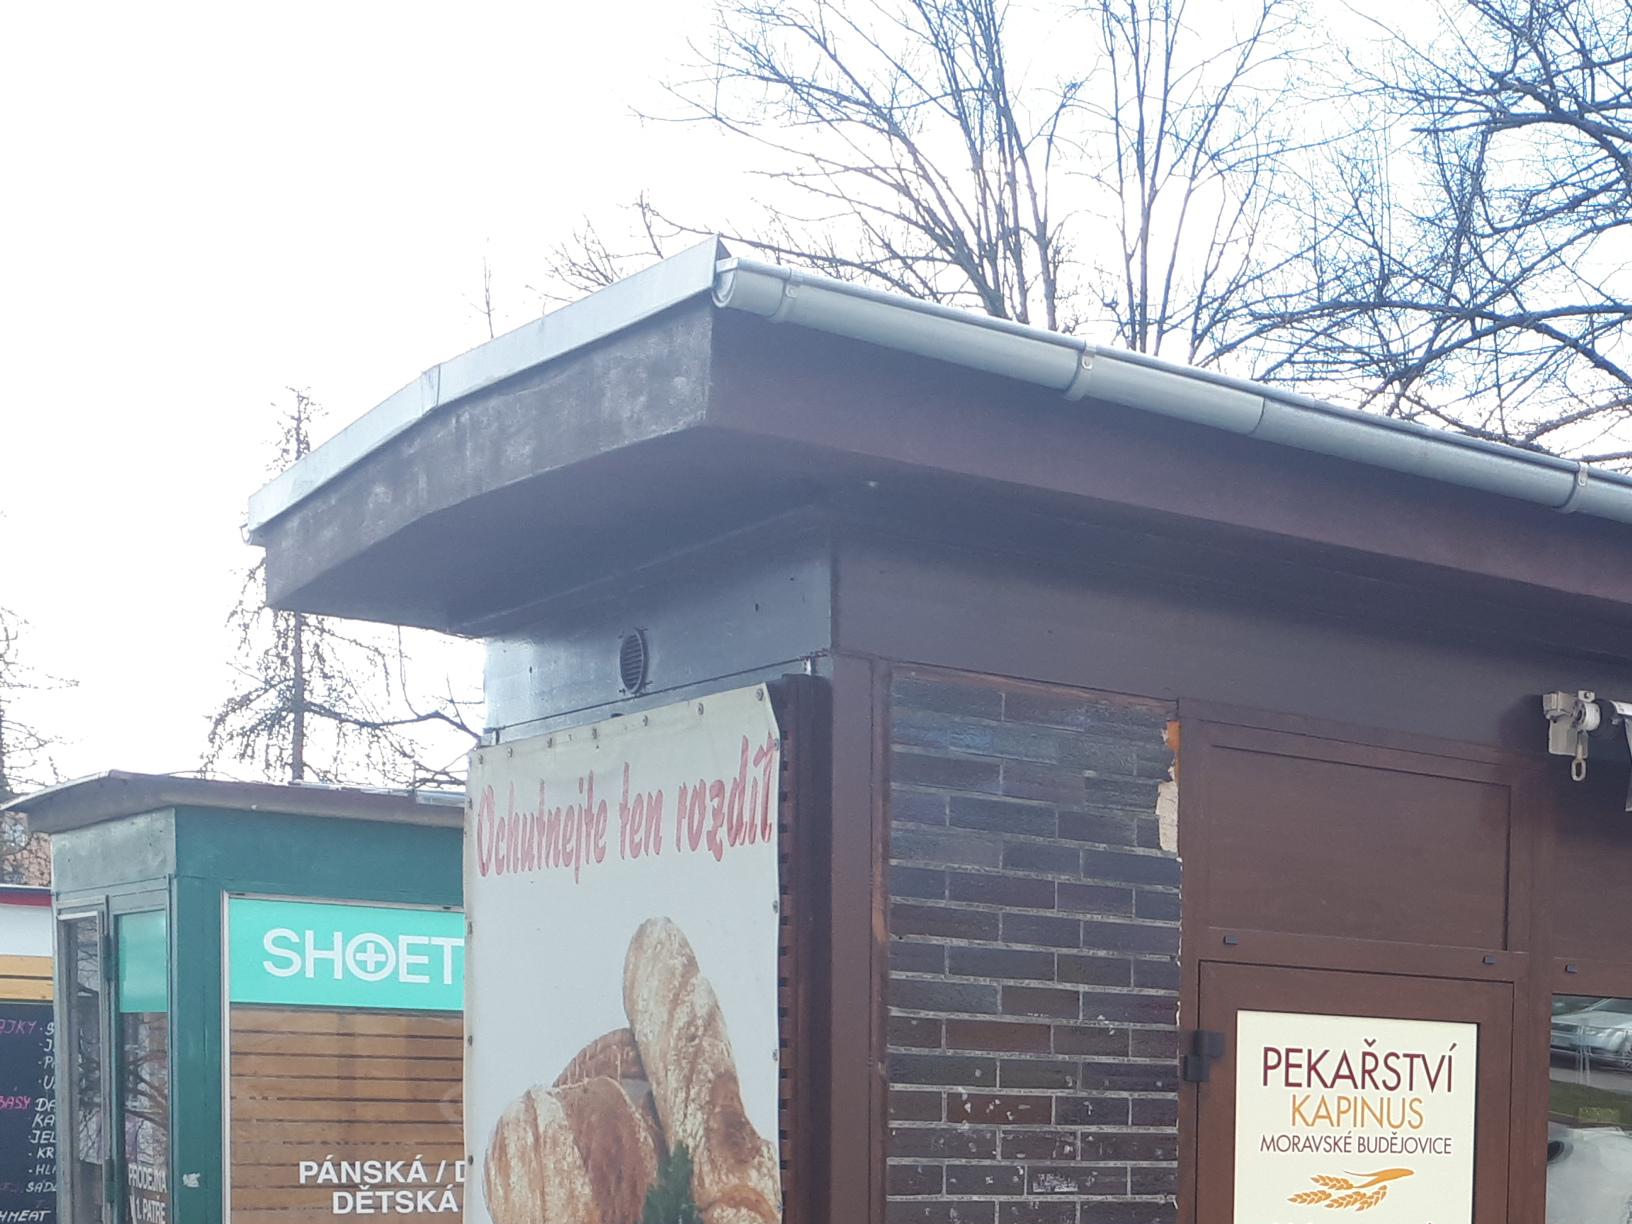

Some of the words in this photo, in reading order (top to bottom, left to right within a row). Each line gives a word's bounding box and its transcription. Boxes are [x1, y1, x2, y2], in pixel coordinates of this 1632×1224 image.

[477, 769, 608, 884] Ochutnejte
[619, 762, 663, 860] ten
[1262, 1038, 1457, 1093] PEKAŘSTVÍ
[1291, 1094, 1424, 1129] KAPINUS
[1260, 1131, 1352, 1153] MORAVSKÉ
[1358, 1132, 1452, 1155] BUDĚJOVICE
[299, 1155, 428, 1184] PÁNSKÁ
[332, 1185, 458, 1215] DĚTSKÁ
